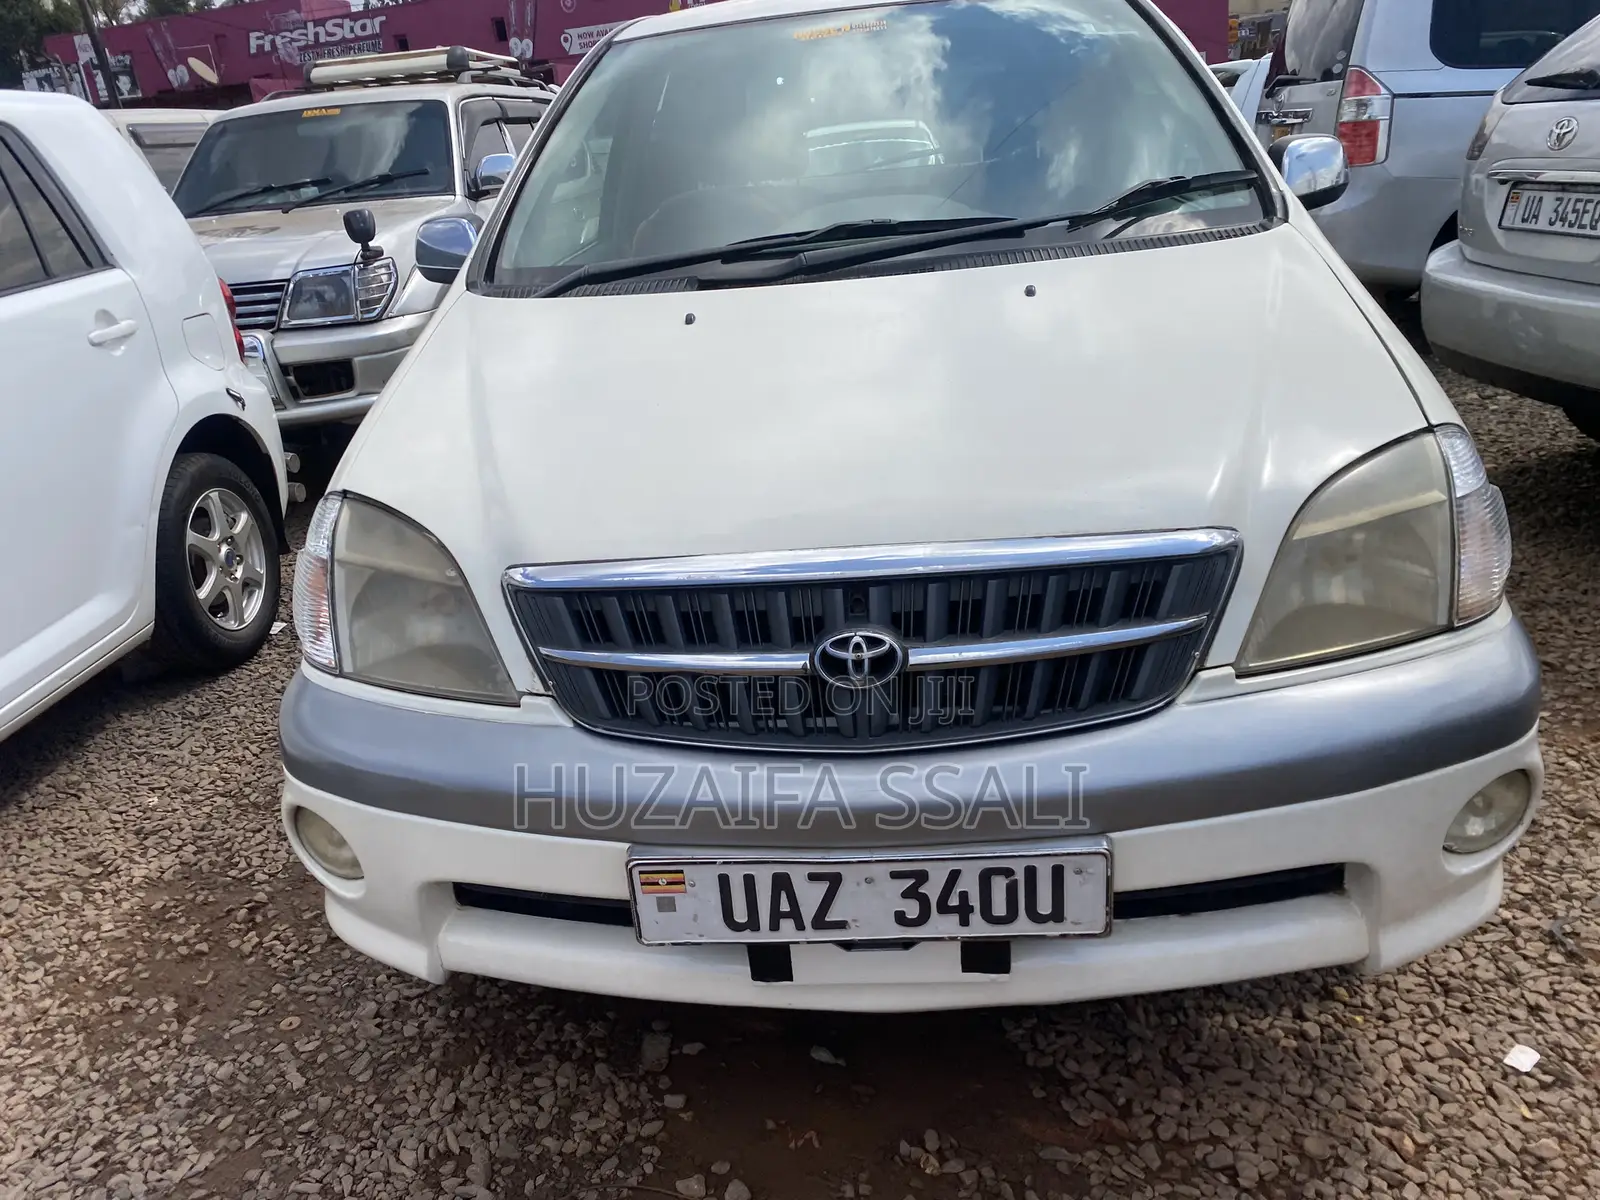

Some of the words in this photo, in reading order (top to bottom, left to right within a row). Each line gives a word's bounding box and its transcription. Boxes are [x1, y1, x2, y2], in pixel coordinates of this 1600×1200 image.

[249, 16, 386, 54] FreshStar
[577, 31, 594, 40] NOW
[1521, 196, 1543, 224] UA
[717, 871, 849, 933] UAZ
[889, 864, 1065, 927] 340U
